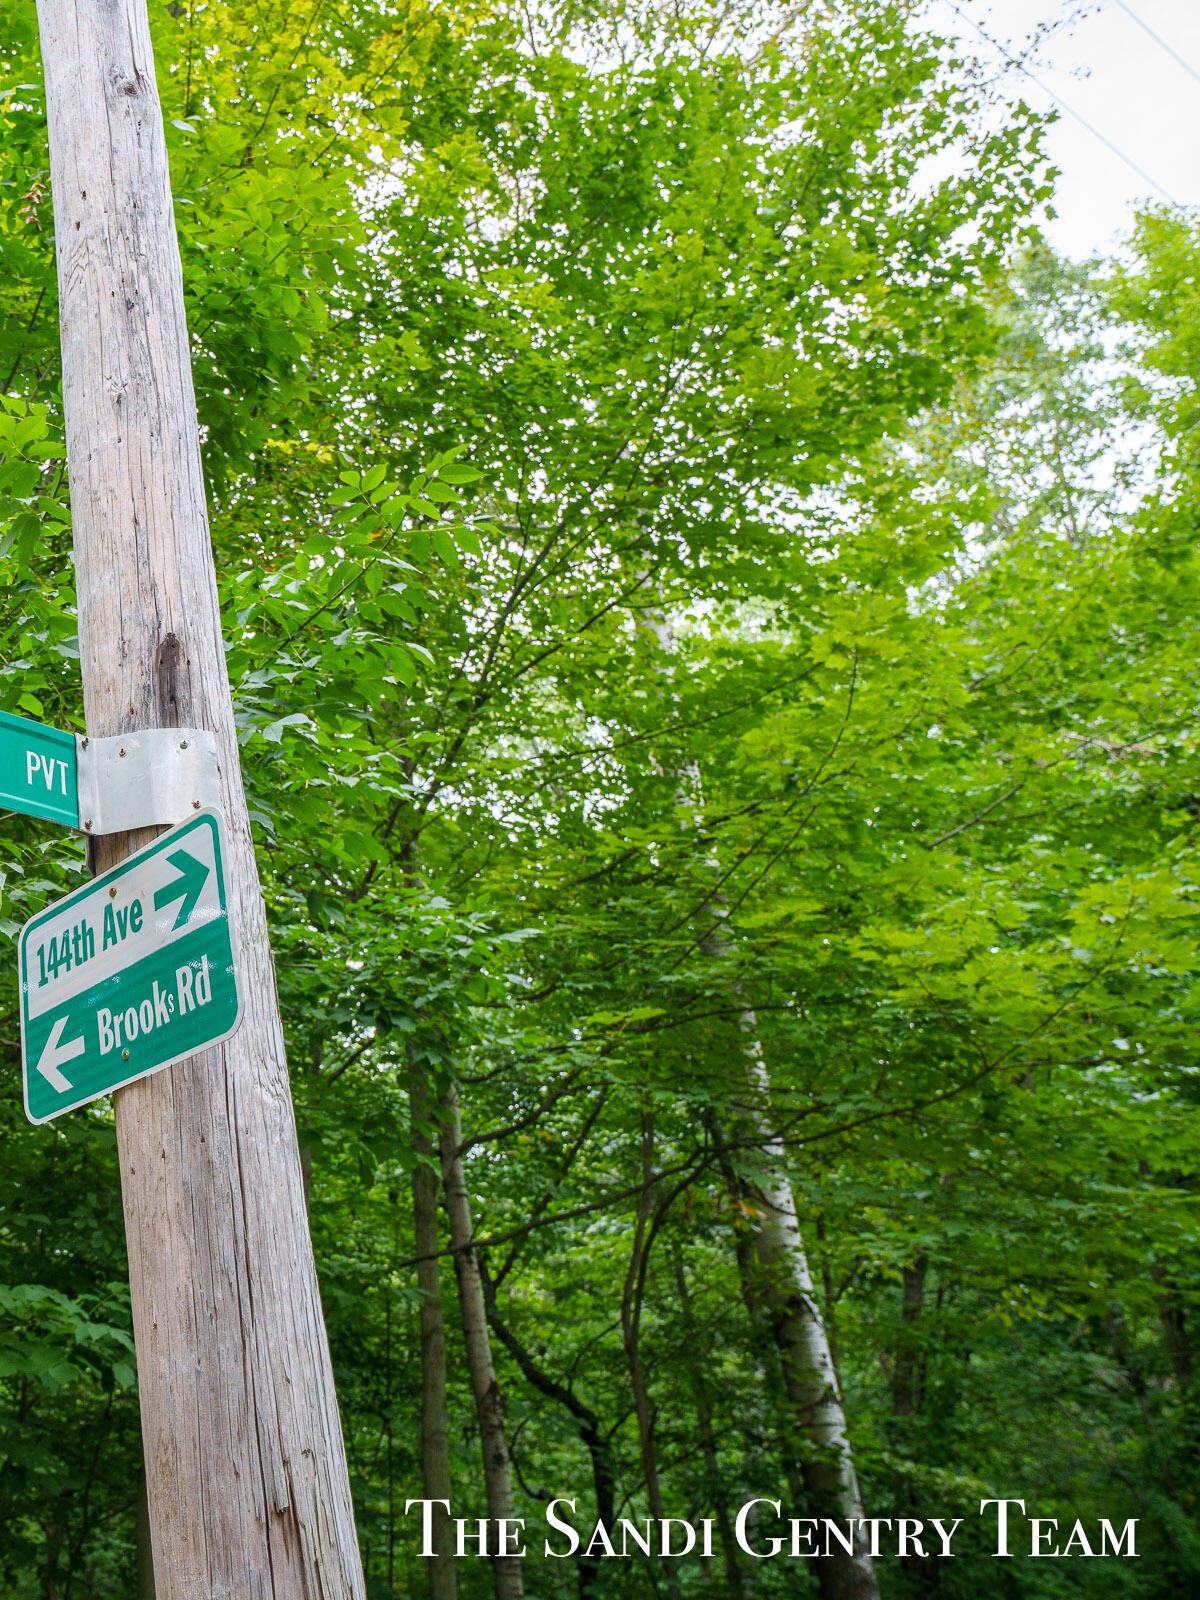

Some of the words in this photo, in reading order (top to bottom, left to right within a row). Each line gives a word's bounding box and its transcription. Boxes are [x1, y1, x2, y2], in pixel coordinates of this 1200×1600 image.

[27, 750, 69, 795] PVT
[37, 918, 95, 988] 144th
[103, 898, 143, 951] Ave
[97, 980, 174, 1055] Brooks
[176, 954, 212, 1016] Rd
